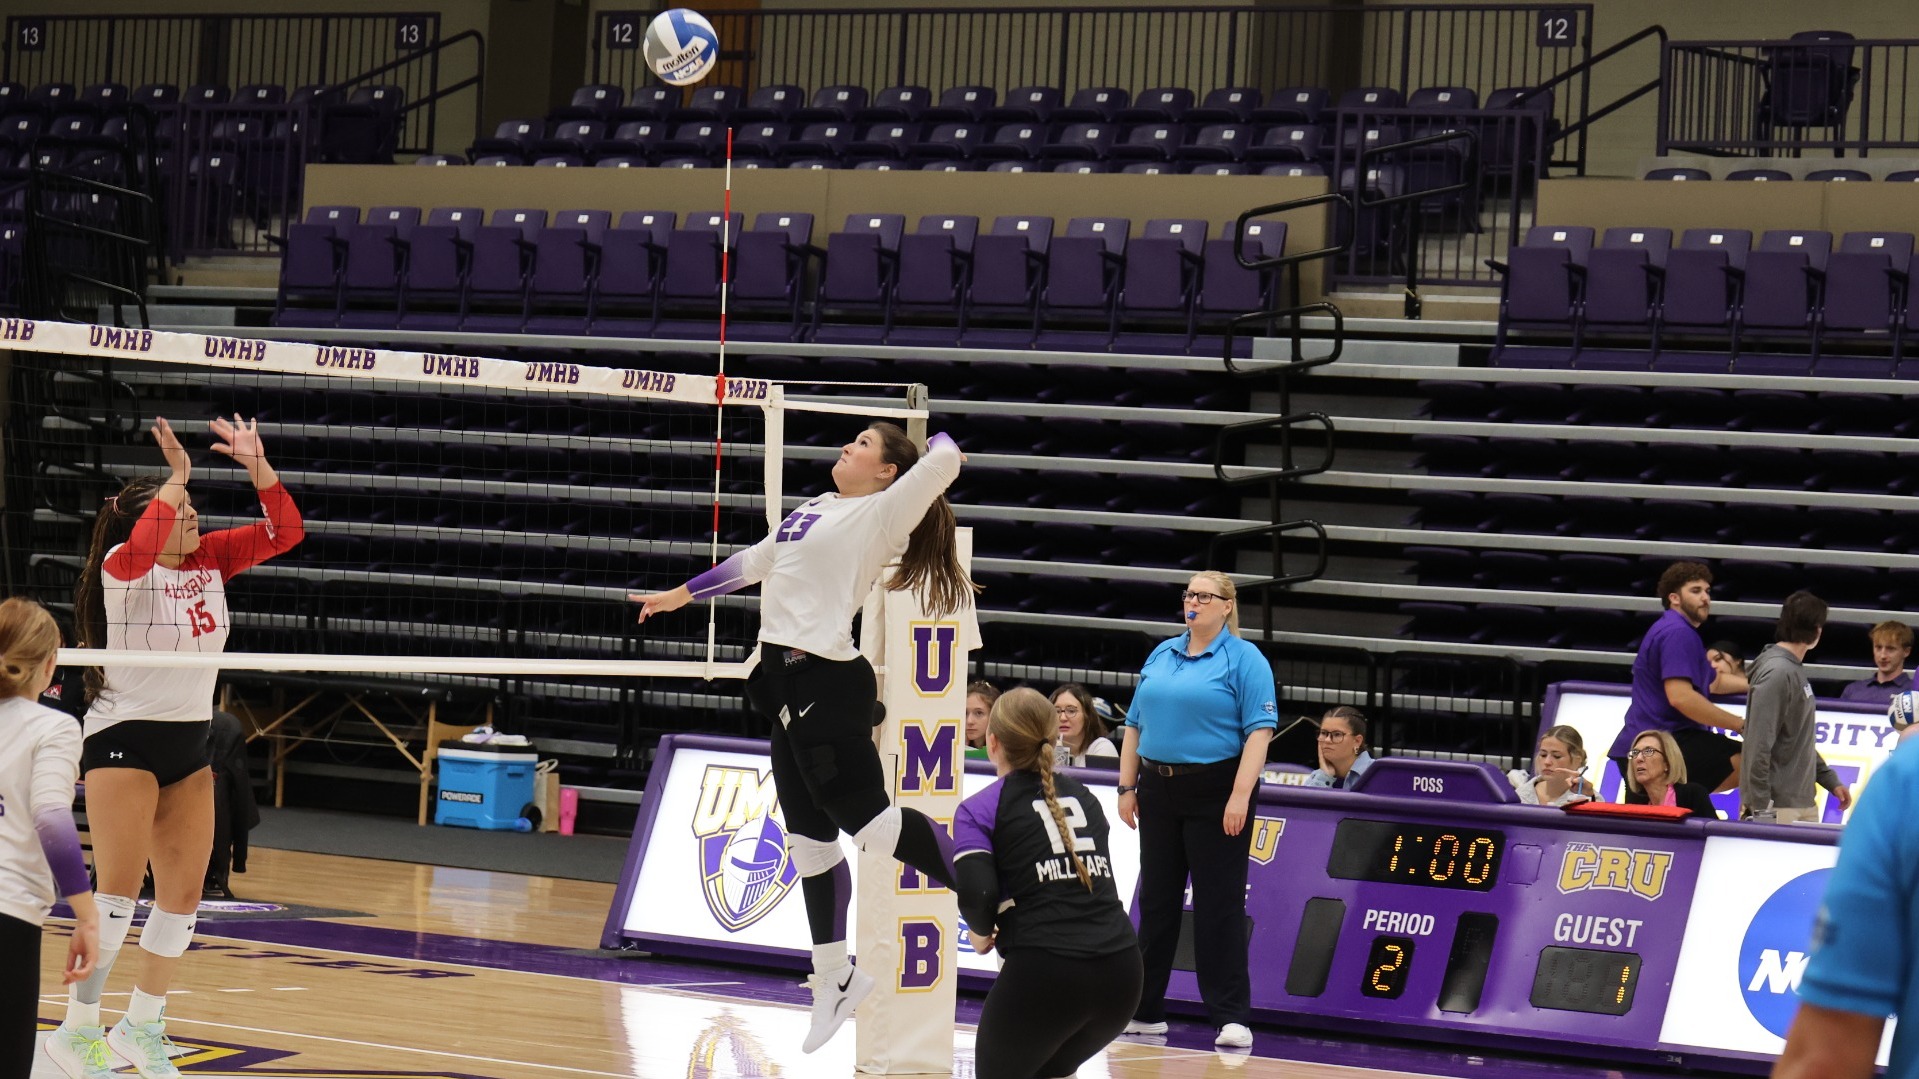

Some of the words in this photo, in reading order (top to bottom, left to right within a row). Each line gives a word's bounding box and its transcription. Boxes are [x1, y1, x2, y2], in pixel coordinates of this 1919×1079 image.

[21, 27, 39, 45] 13
[400, 24, 419, 44] 13
[612, 23, 633, 43] 12
[1544, 18, 1568, 39] 12
[662, 45, 699, 71] molten
[0, 317, 35, 341] HB
[89, 324, 153, 352] UMHB
[205, 336, 267, 361] UMHB
[315, 346, 376, 370] UMHB
[422, 353, 480, 378] UMHB
[525, 362, 580, 385] UMHB
[622, 369, 676, 393] UMHB
[717, 379, 768, 400] MHB
[775, 511, 822, 543] 23
[186, 600, 217, 638] 15
[441, 790, 482, 804] POWERADE
[1413, 776, 1444, 793] POSS
[1032, 796, 1096, 854] 12
[1390, 834, 1495, 884] 1:00
[1565, 841, 1593, 853] THE
[1035, 855, 1111, 883] MILLAPS
[1556, 846, 1675, 901] CRU
[1363, 909, 1435, 936] PERIOD
[1554, 913, 1643, 948] GUEST
[1371, 944, 1404, 992] 2
[1616, 966, 1631, 1004] 1
